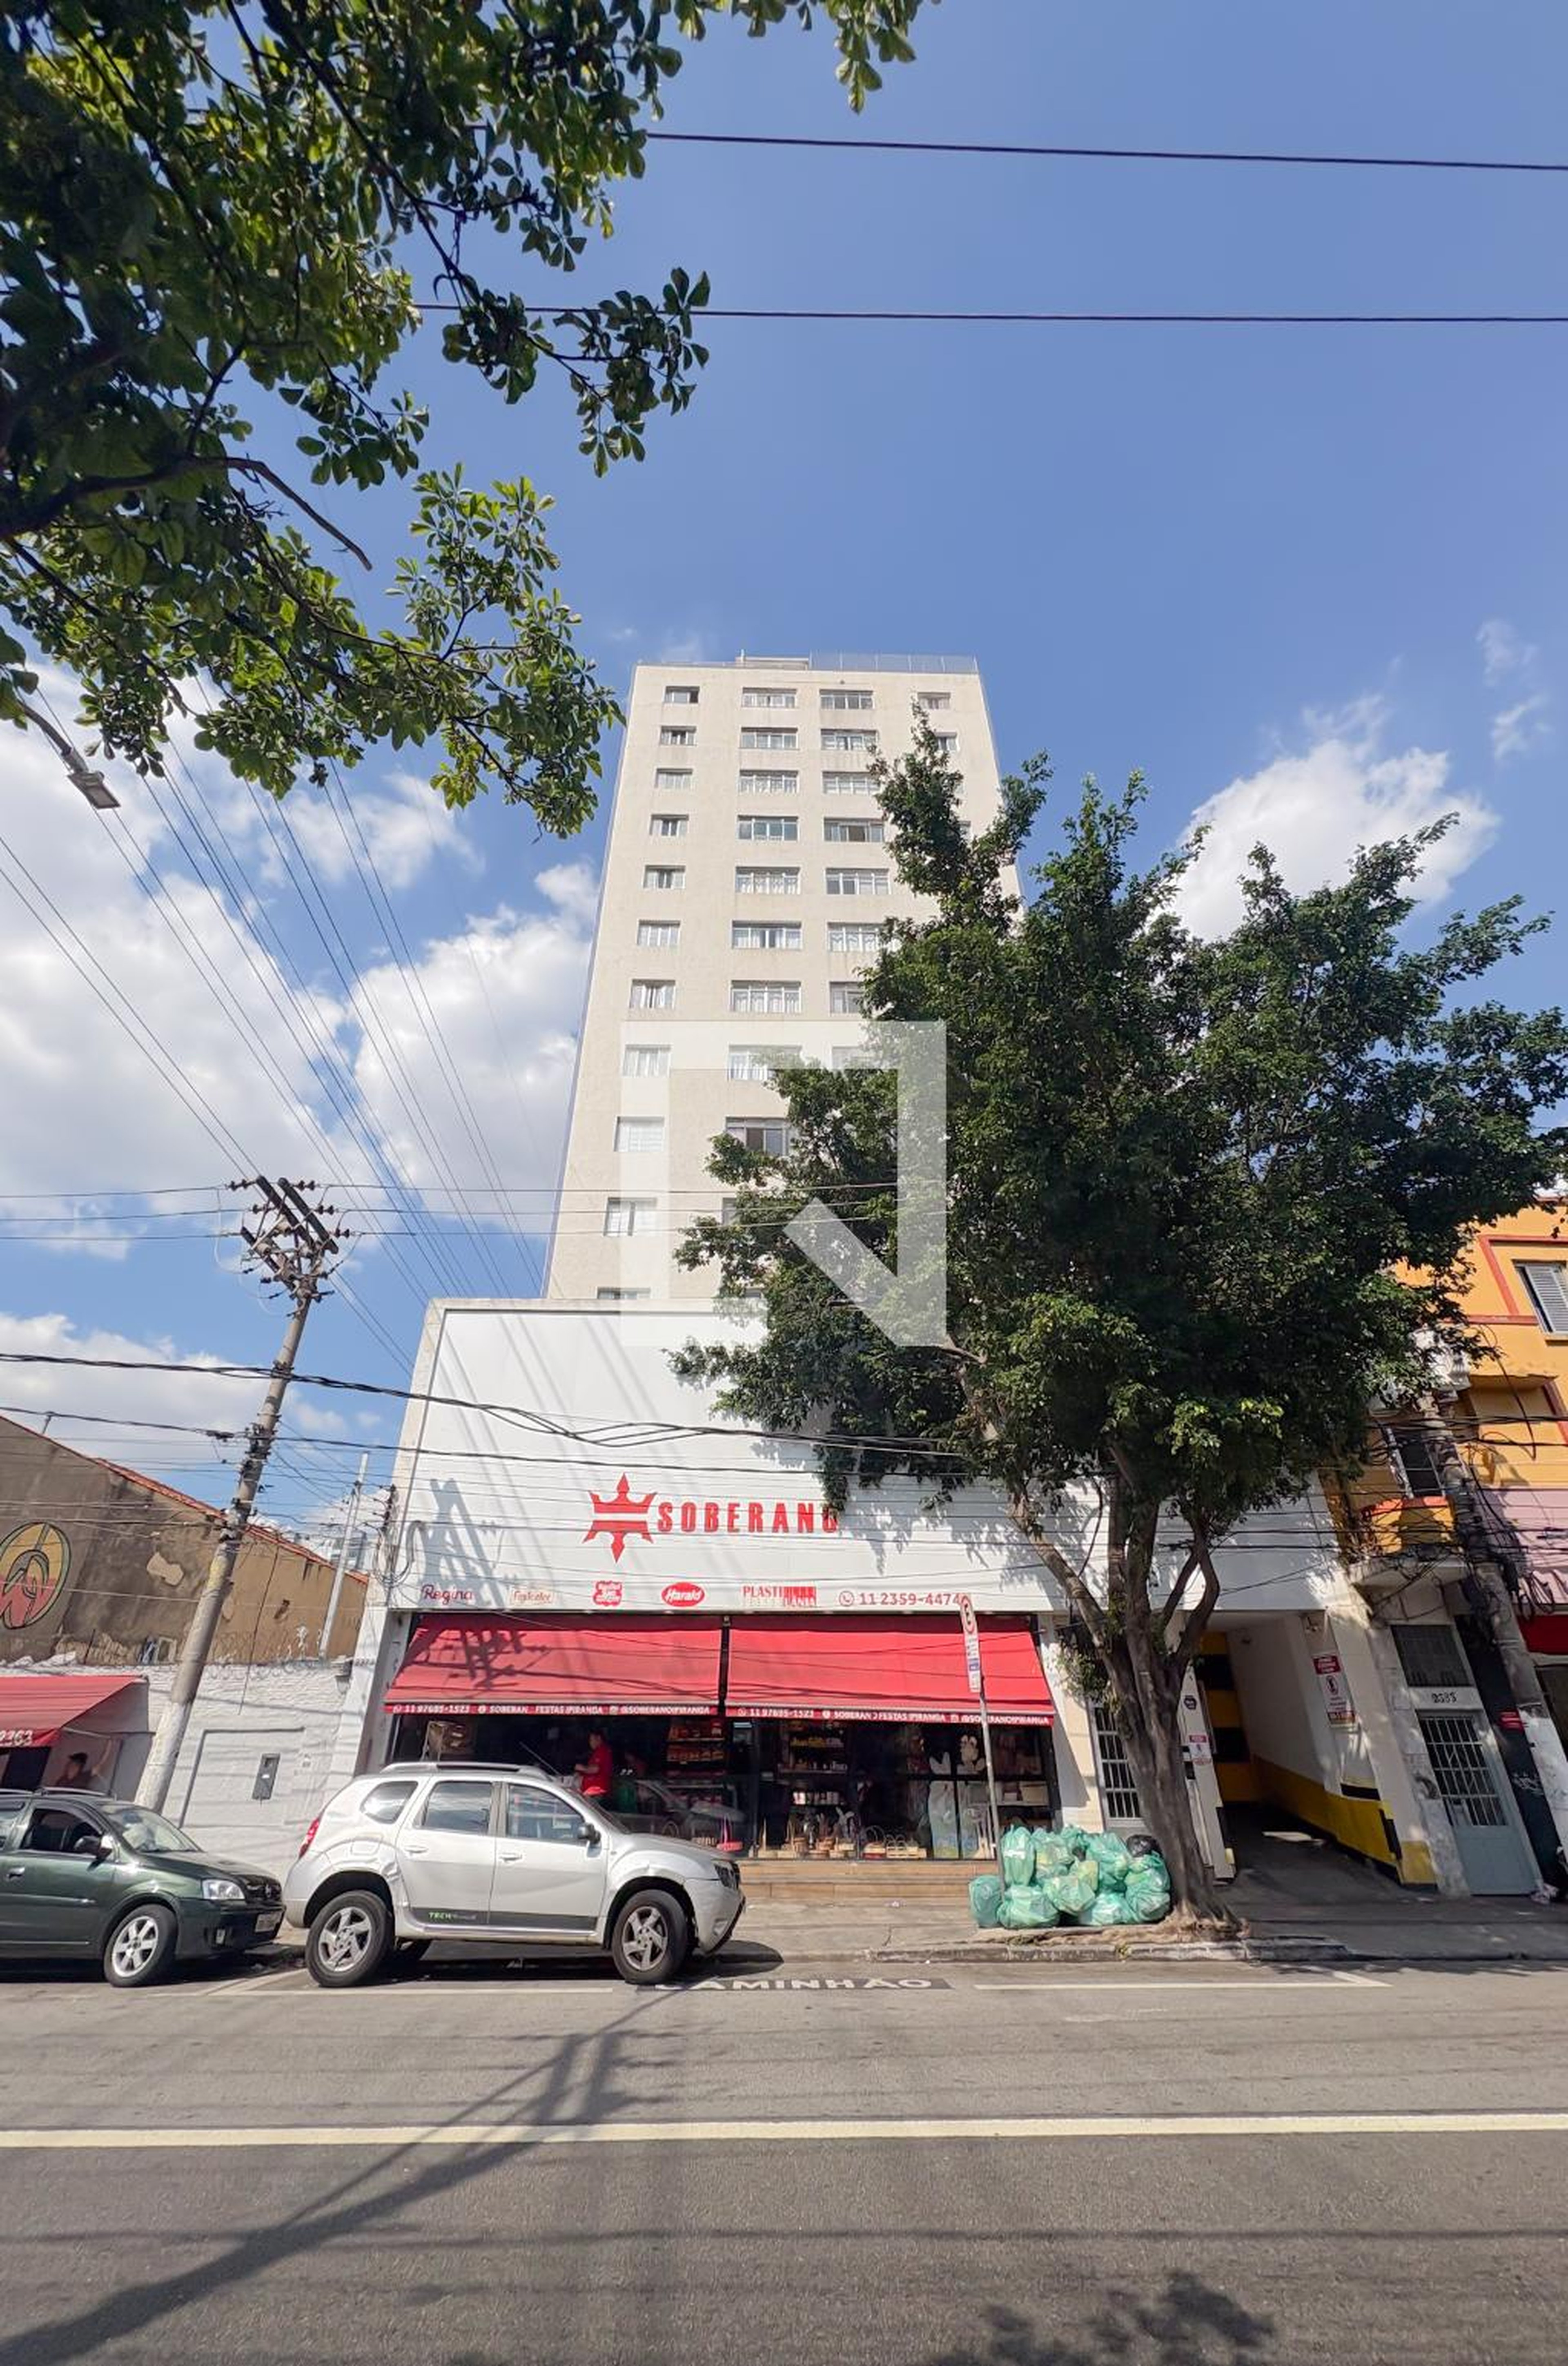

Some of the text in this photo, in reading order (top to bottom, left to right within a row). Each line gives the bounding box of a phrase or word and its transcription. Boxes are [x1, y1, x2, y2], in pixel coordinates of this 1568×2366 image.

[421, 1584, 472, 1604] Regina
[664, 1588, 702, 1602] Harald
[859, 1593, 960, 1606] 11 2359-4474
